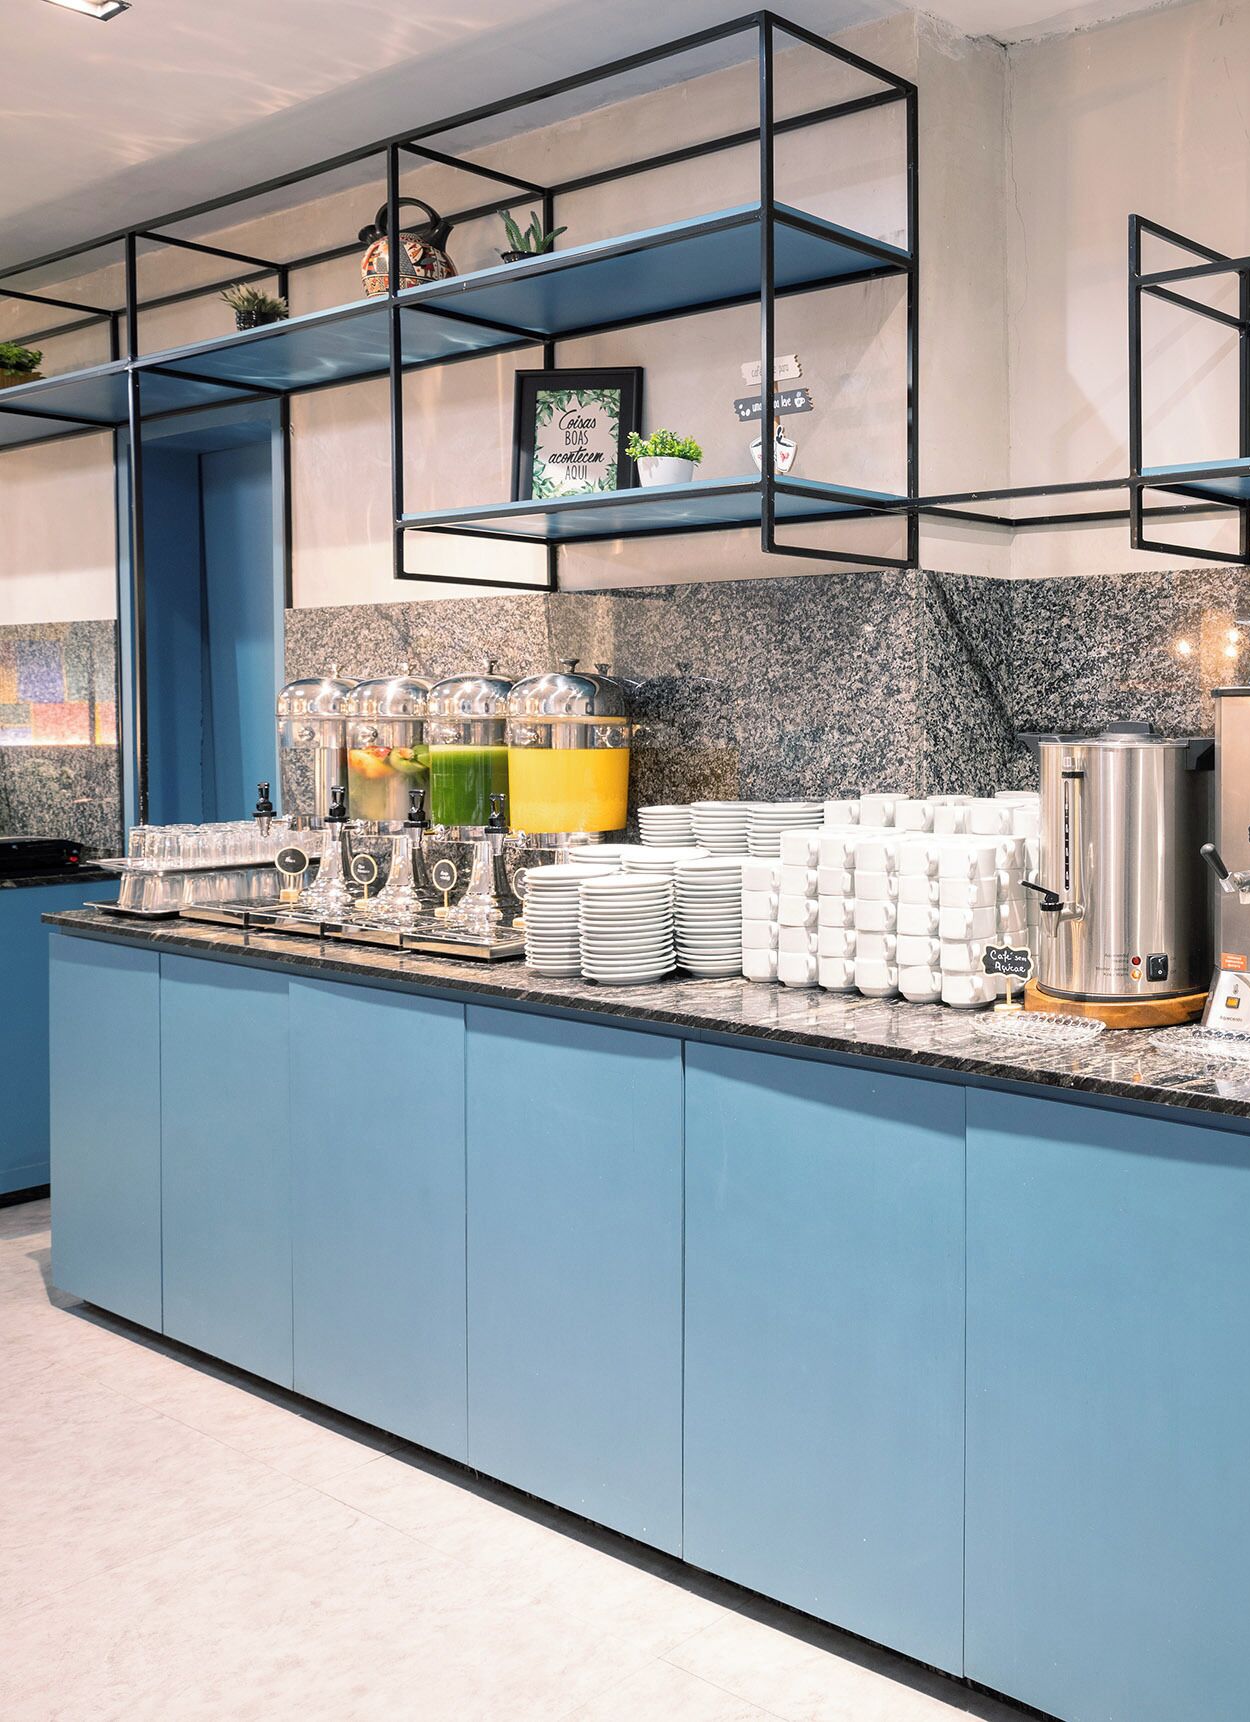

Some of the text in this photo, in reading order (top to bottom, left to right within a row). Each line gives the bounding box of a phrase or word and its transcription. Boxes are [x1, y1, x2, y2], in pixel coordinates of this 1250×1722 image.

[558, 409, 596, 430] Coisas
[565, 430, 589, 446] BOAS
[548, 446, 605, 464] acontecem
[565, 465, 587, 480] AQUI
[990, 950, 1013, 962] Café
